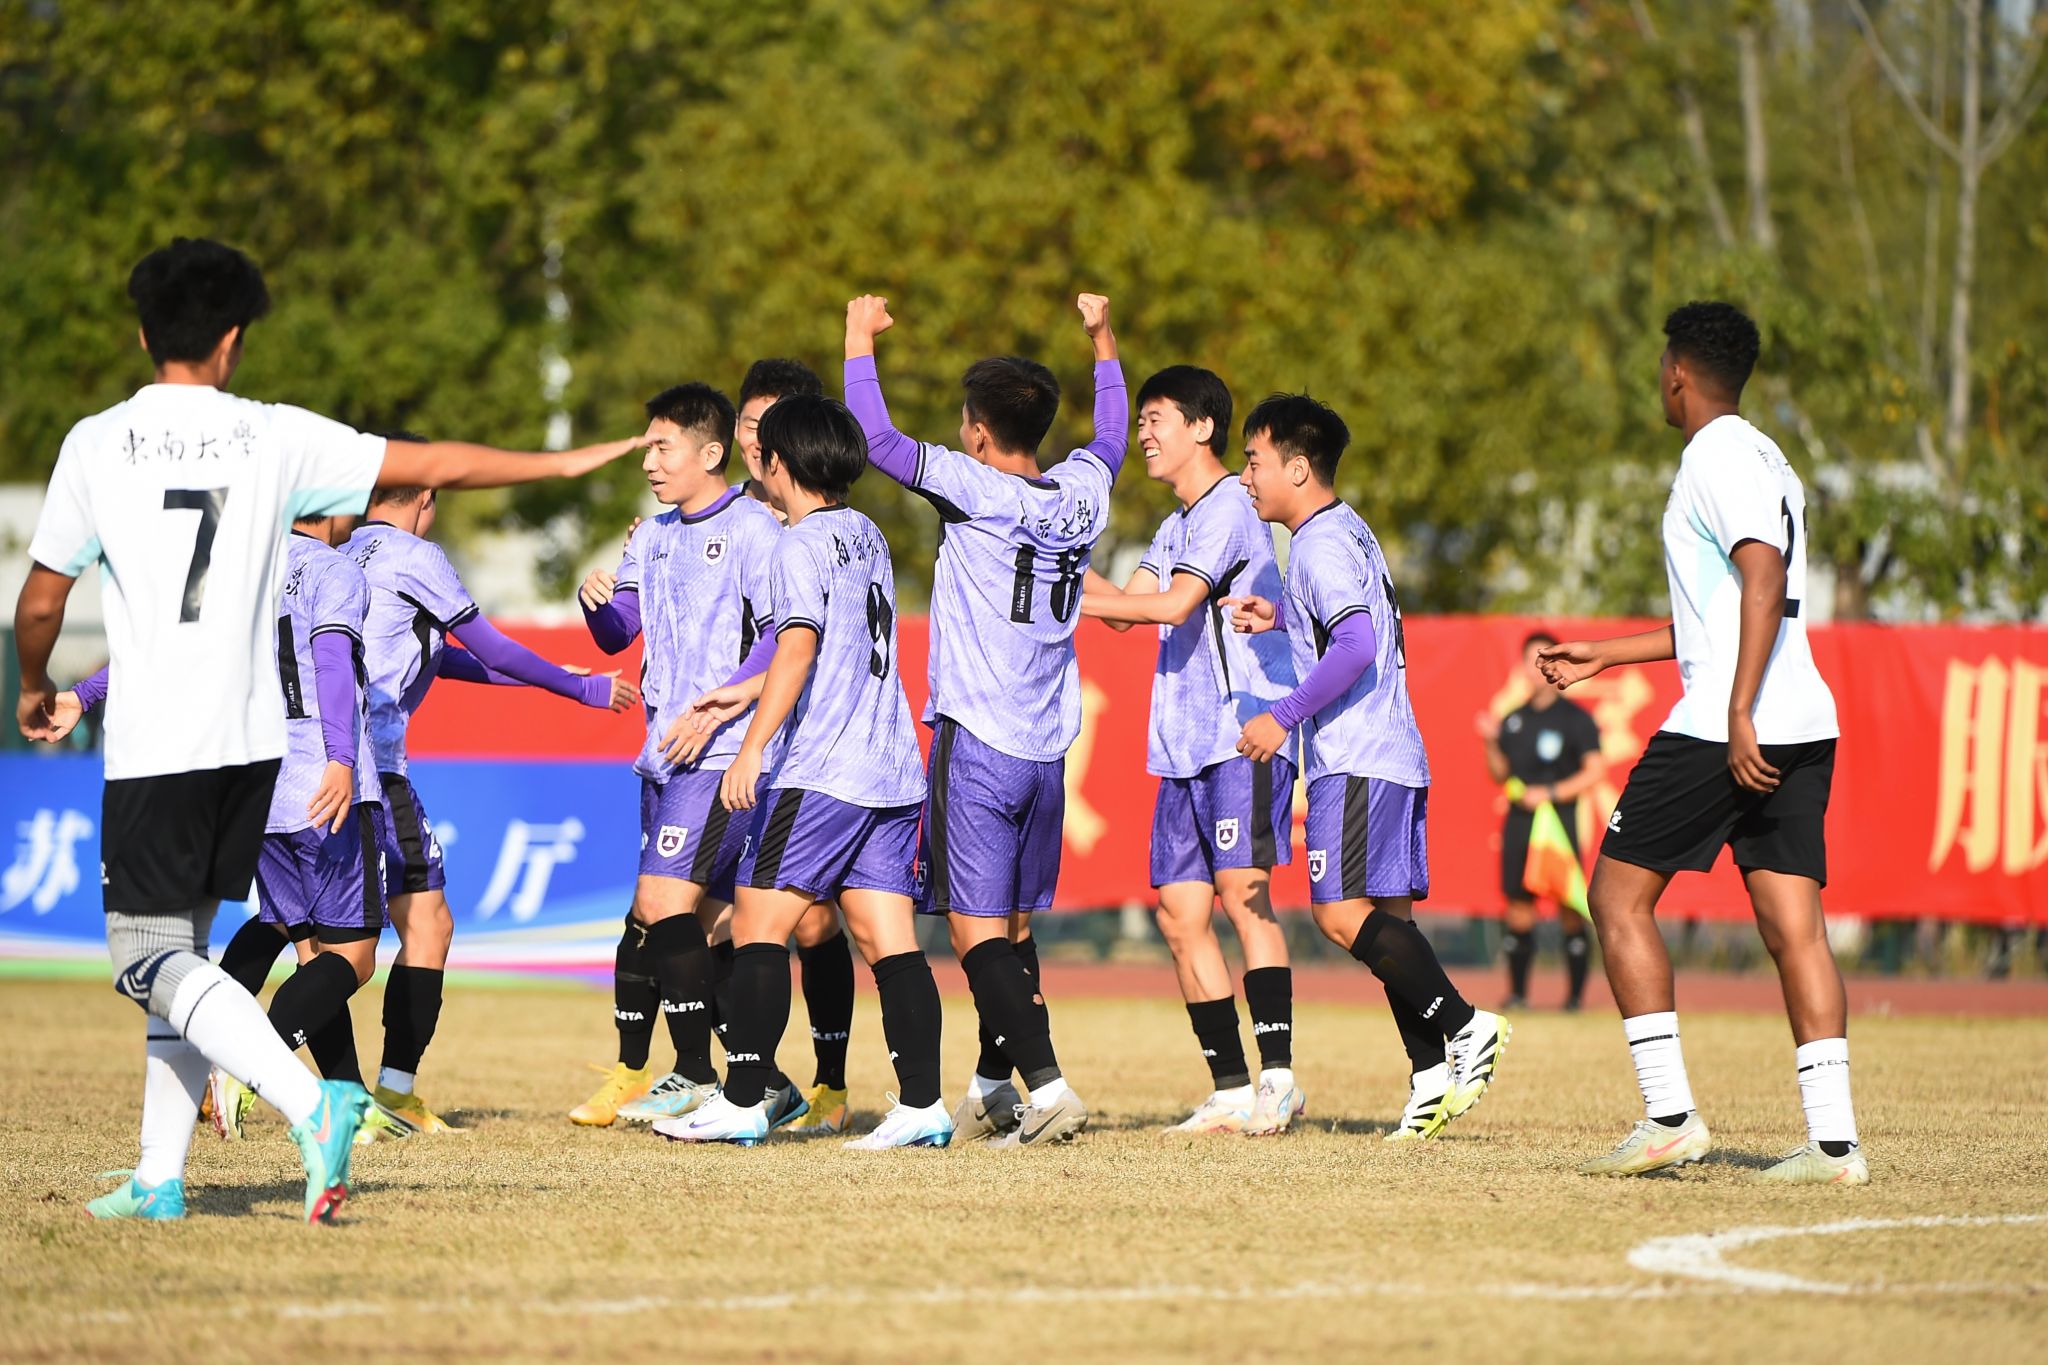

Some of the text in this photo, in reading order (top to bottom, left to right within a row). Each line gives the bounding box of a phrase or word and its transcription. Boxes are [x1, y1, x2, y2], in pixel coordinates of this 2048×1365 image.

[163, 487, 229, 623] 7
[832, 534, 891, 568] 南京大
[1011, 542, 1091, 624] 18
[867, 581, 893, 682] 9
[0, 808, 95, 915] 苏
[475, 816, 585, 923] 厅
